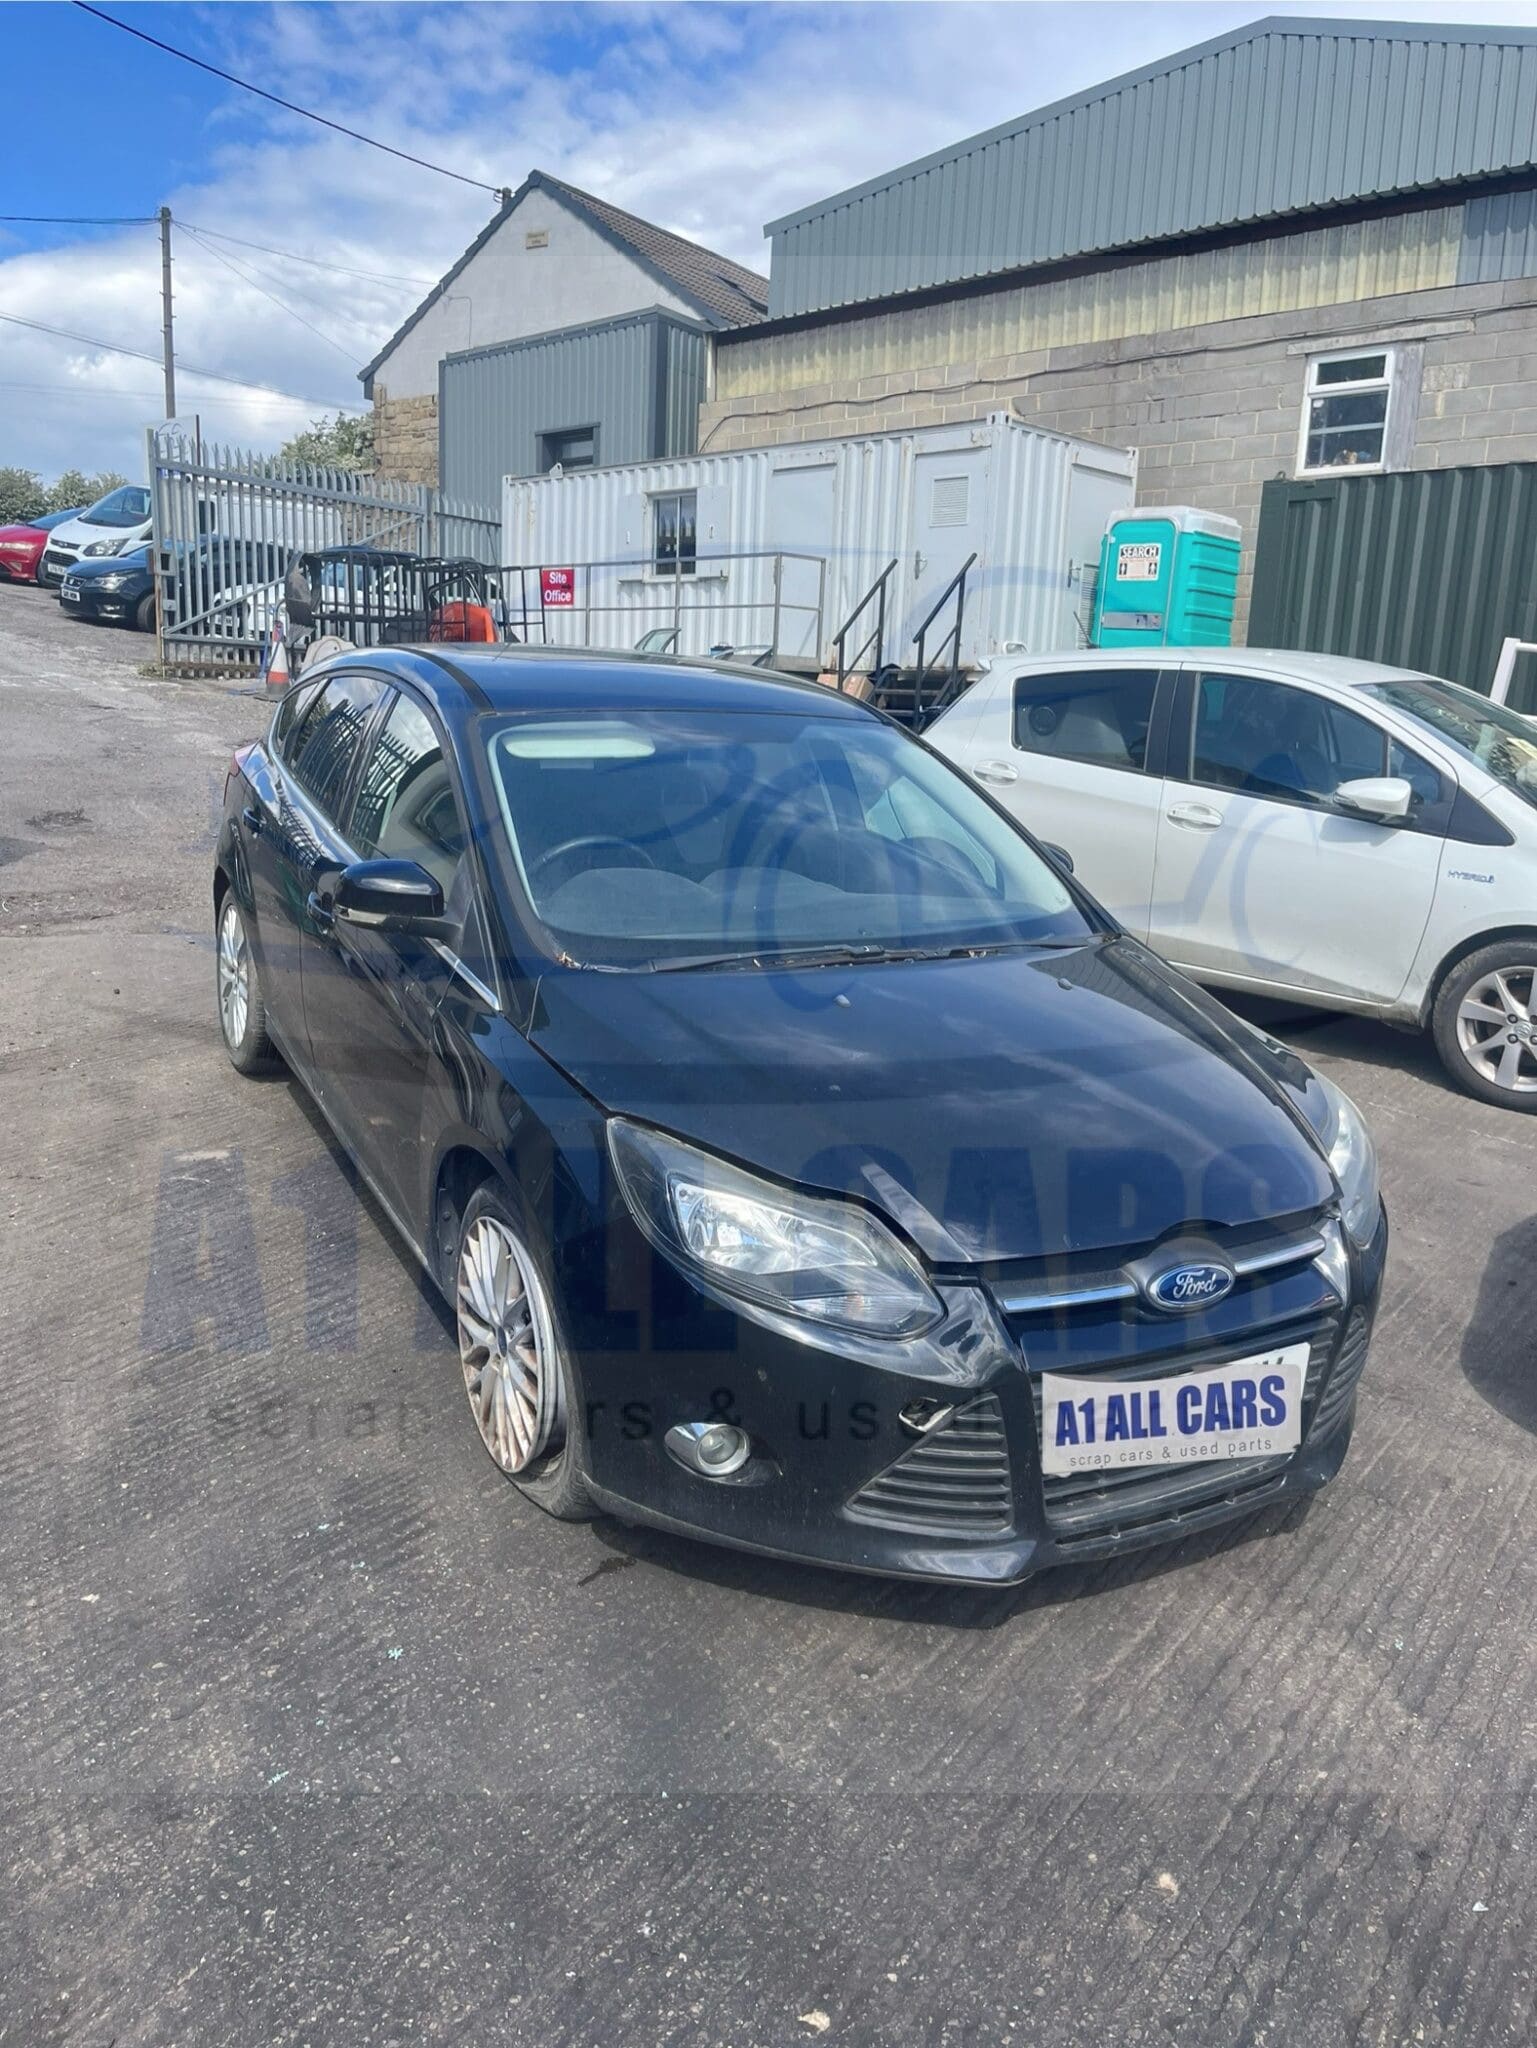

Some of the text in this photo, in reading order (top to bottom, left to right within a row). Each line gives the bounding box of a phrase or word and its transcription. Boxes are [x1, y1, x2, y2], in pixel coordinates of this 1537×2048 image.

[1122, 547, 1157, 558] SEARCH
[549, 571, 567, 584] Site
[544, 590, 572, 602] Office
[1172, 1269, 1217, 1299] Ford
[1055, 1375, 1287, 1447] A1 ALL CARS
[1070, 1438, 1272, 1467] scrap cars & used parts
